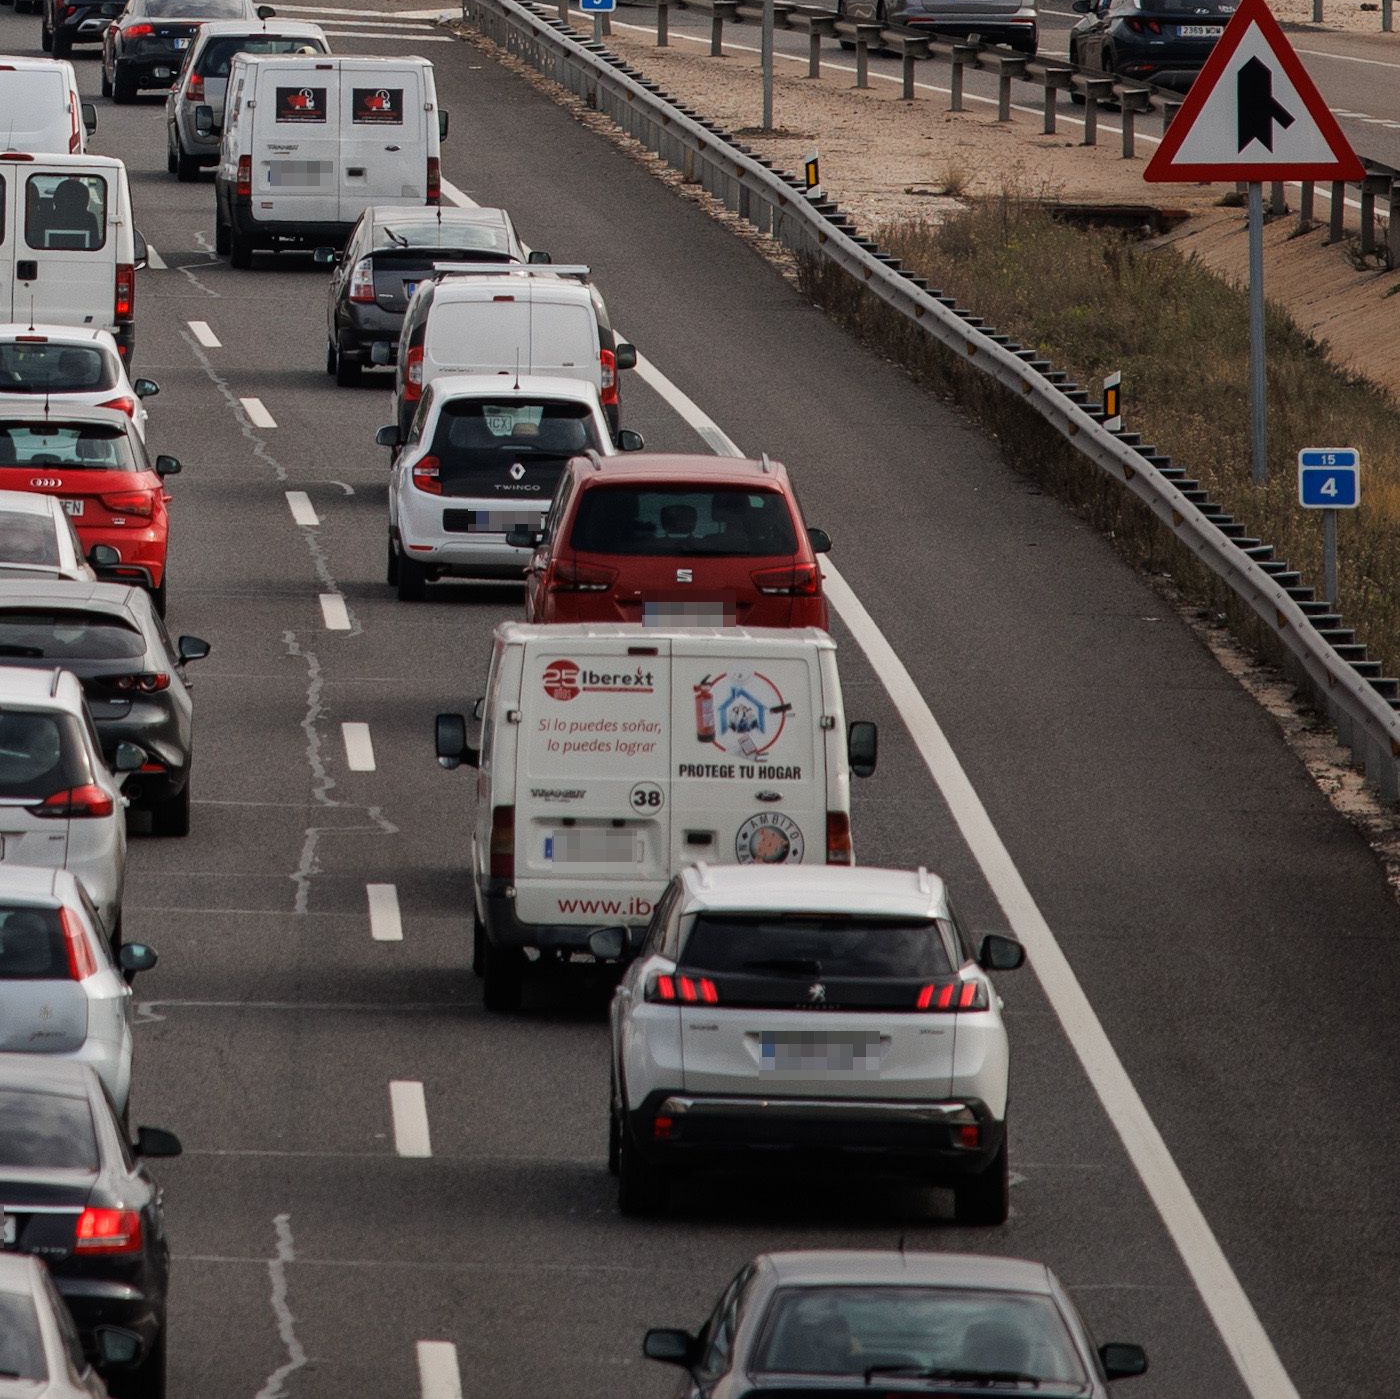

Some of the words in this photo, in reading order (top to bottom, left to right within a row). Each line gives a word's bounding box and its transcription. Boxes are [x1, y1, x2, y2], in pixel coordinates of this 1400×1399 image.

[1321, 454, 1336, 465] 15
[494, 484, 541, 492] TWINGO
[1320, 477, 1339, 498] 4
[542, 669, 580, 688] 25
[582, 668, 654, 686] Iberext
[554, 718, 567, 731] lo
[569, 718, 618, 734] puedes
[622, 719, 662, 735] soñar,
[547, 739, 560, 752] lo
[563, 739, 612, 755] puedes
[615, 739, 657, 756] lograr
[679, 764, 735, 778] PROTEGE
[740, 765, 755, 779] TU
[758, 766, 802, 780] HOGAR
[633, 790, 661, 807] 38
[558, 896, 658, 916] www.ib
